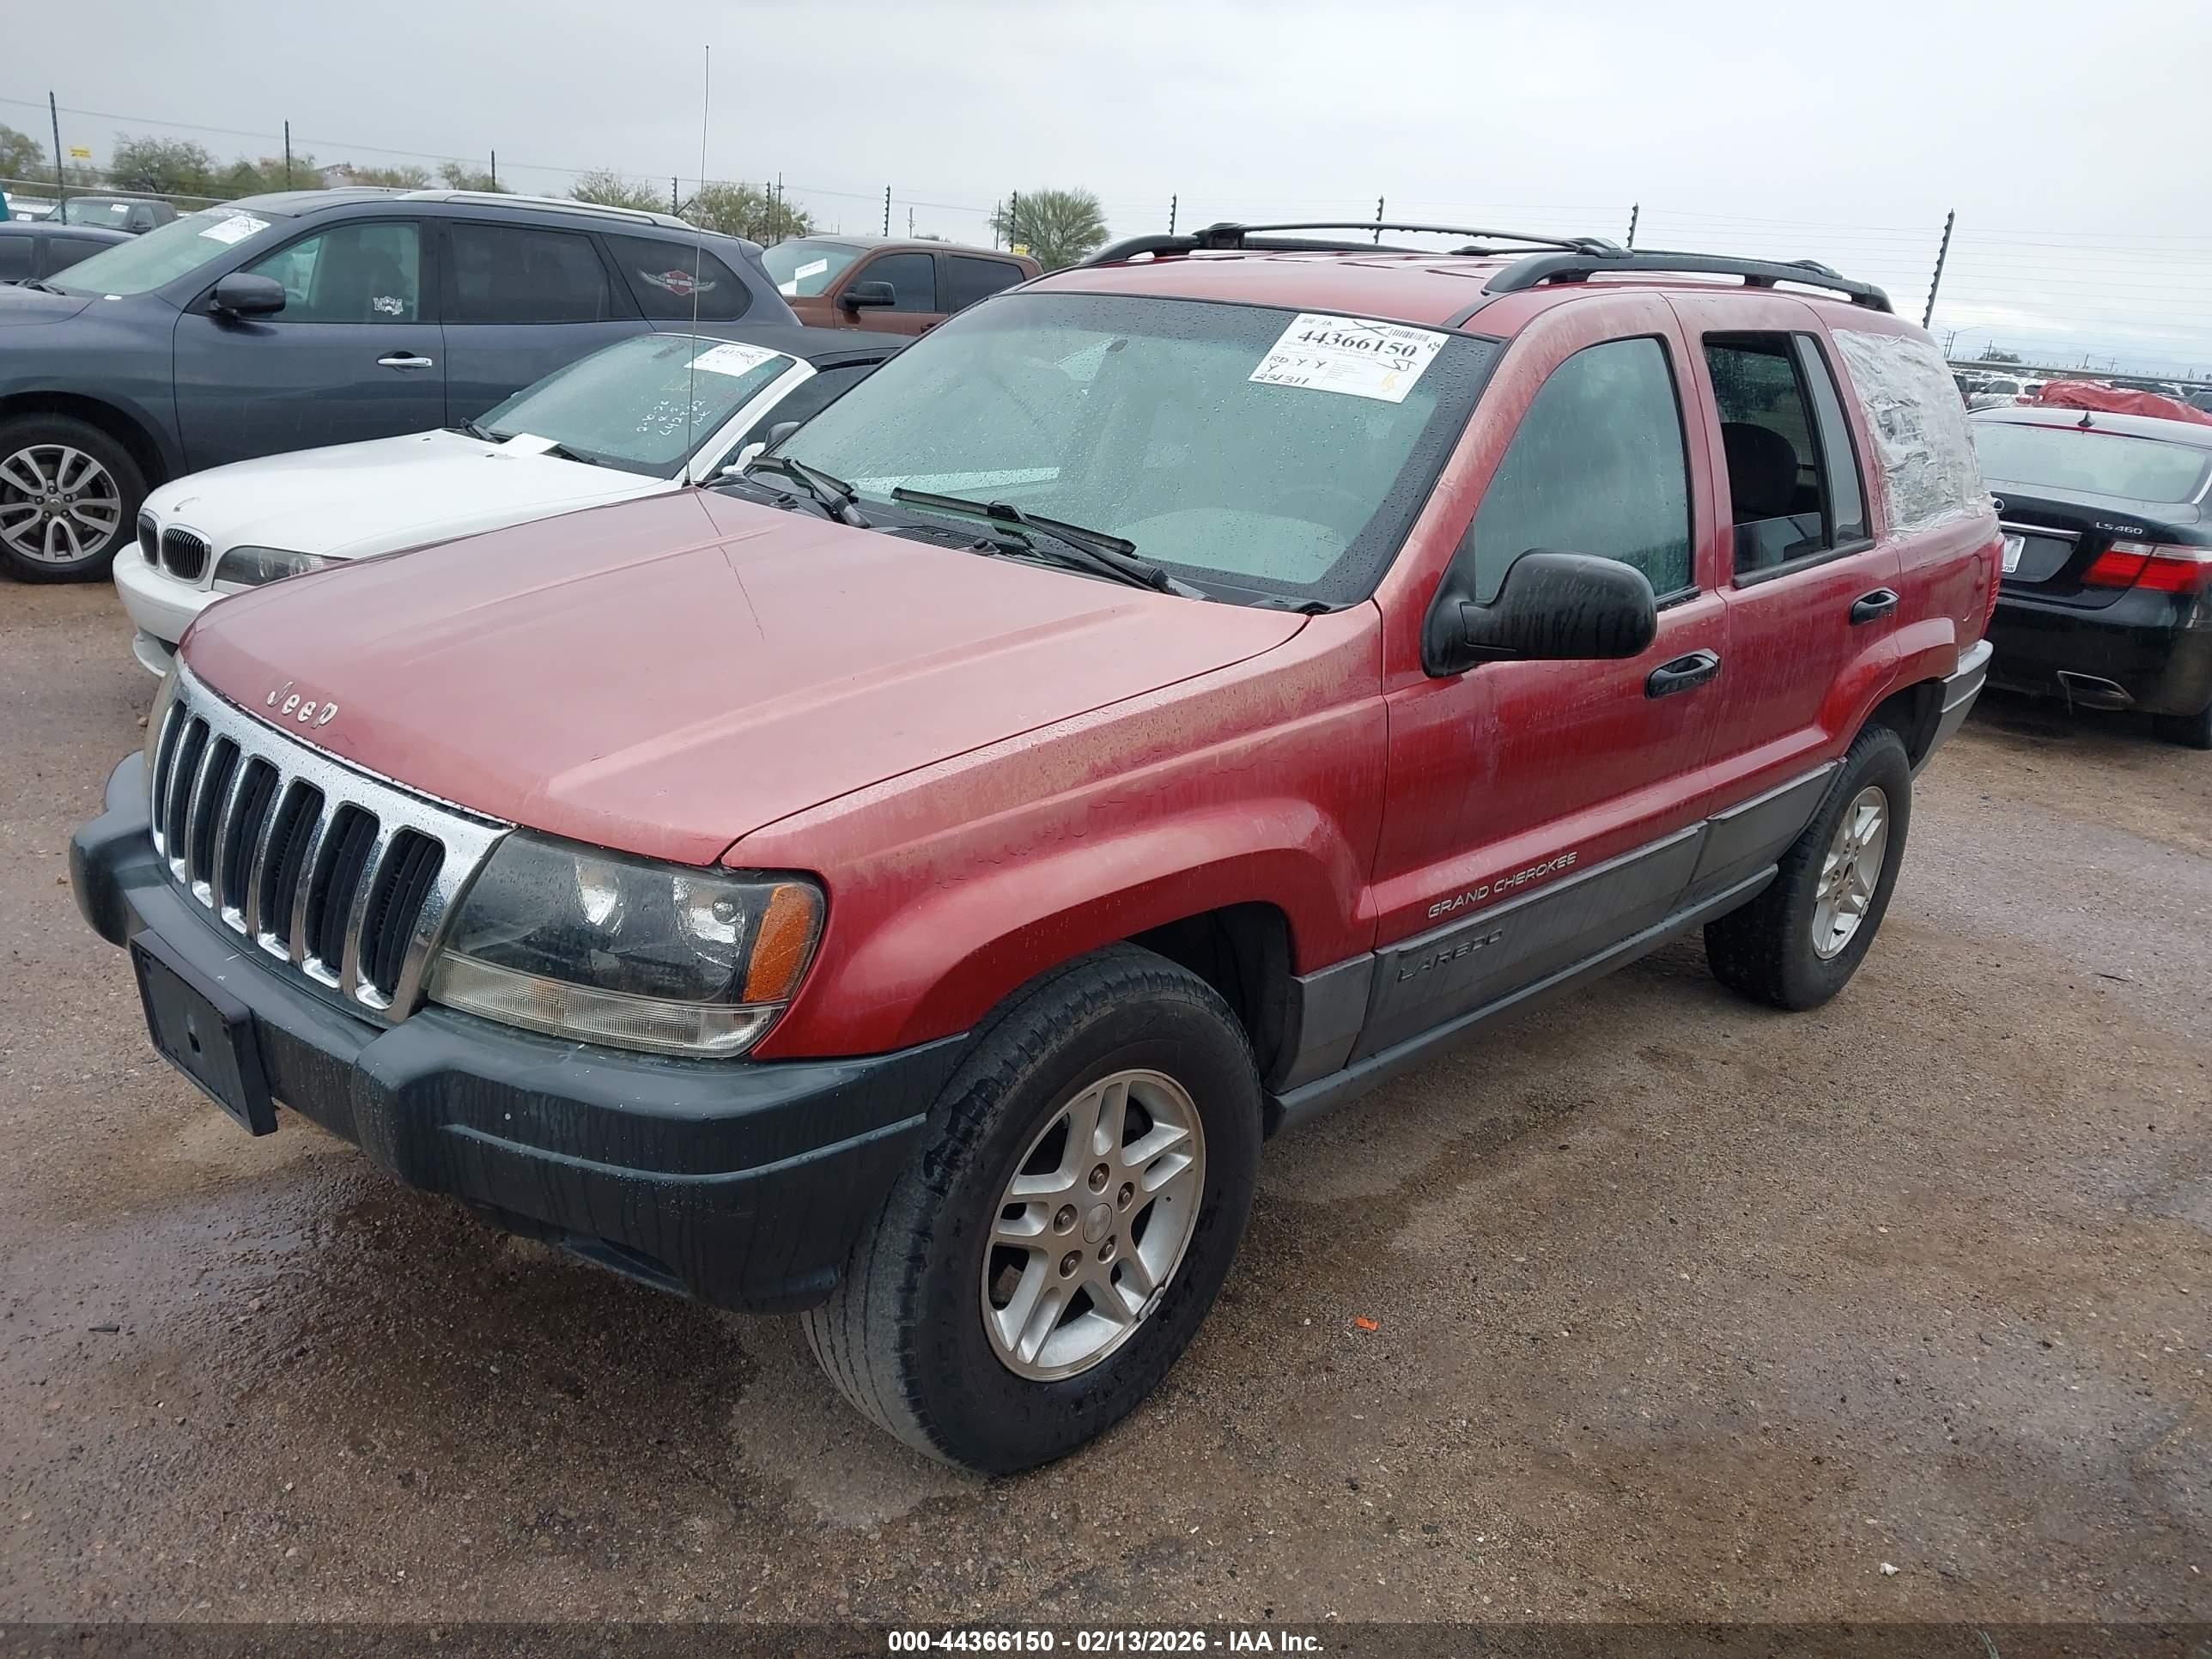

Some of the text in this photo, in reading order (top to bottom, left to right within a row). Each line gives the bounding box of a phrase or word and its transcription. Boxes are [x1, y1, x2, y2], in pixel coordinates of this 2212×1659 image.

[1298, 330, 1417, 357] 44366150
[1315, 360, 1327, 368] Y
[267, 681, 338, 729] Jeep
[1428, 851, 1578, 919] GRAND CHEROKEE
[1396, 928, 1504, 983] LAREDO
